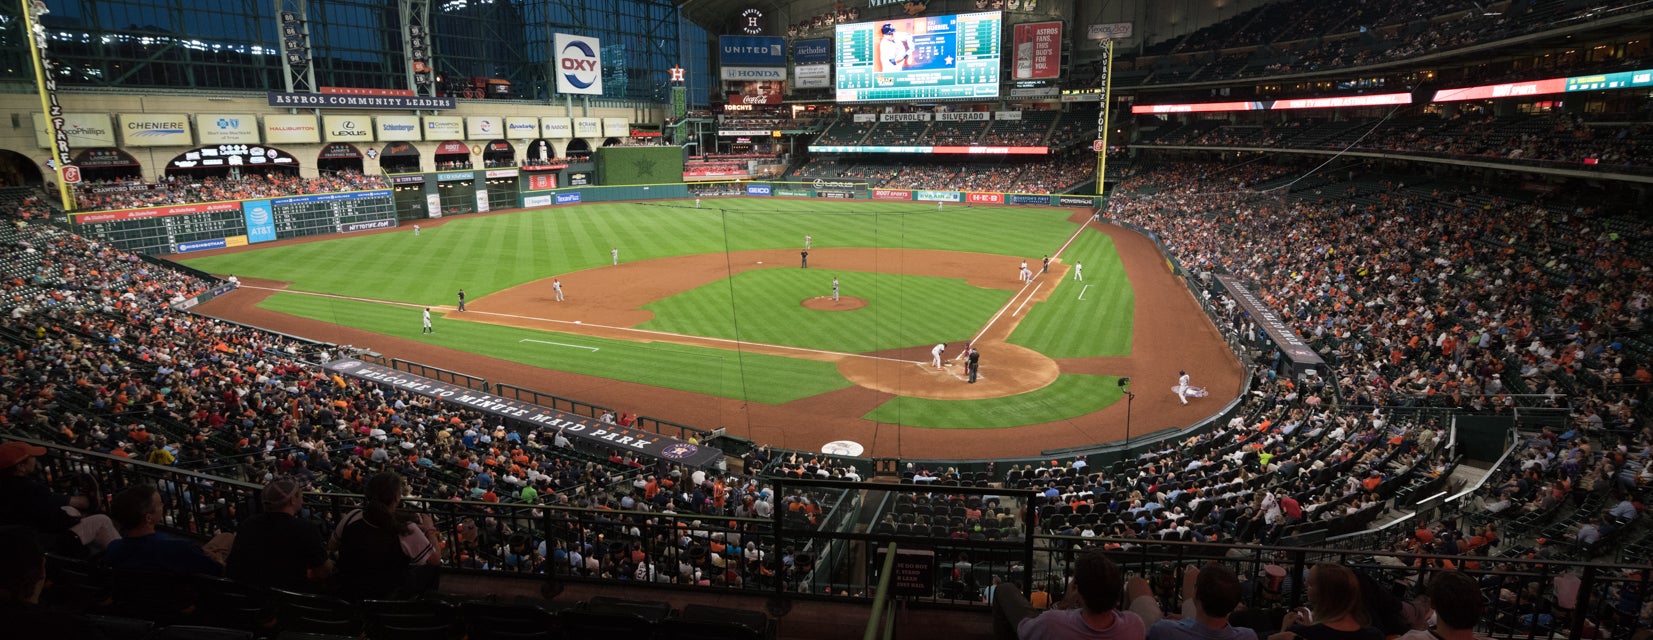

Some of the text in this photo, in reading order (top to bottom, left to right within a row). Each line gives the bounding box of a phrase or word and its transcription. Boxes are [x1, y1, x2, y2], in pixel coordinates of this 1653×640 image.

[748, 17, 758, 27] H
[724, 46, 768, 54] UNITED
[561, 57, 597, 72] OXY
[670, 68, 685, 81] H
[738, 70, 780, 78] HONDA
[330, 96, 402, 105] COMMUNITY
[406, 98, 450, 107] LEADERS
[942, 112, 984, 120] SILVERADO
[128, 122, 184, 130] CHENIERE
[53, 118, 71, 164] FARE
[251, 225, 272, 235] AT&T
[355, 368, 432, 391] WELCOME
[430, 387, 454, 397] TO
[455, 395, 530, 417] MINUTE
[529, 413, 586, 432] MAID
[589, 429, 652, 448] PARK
